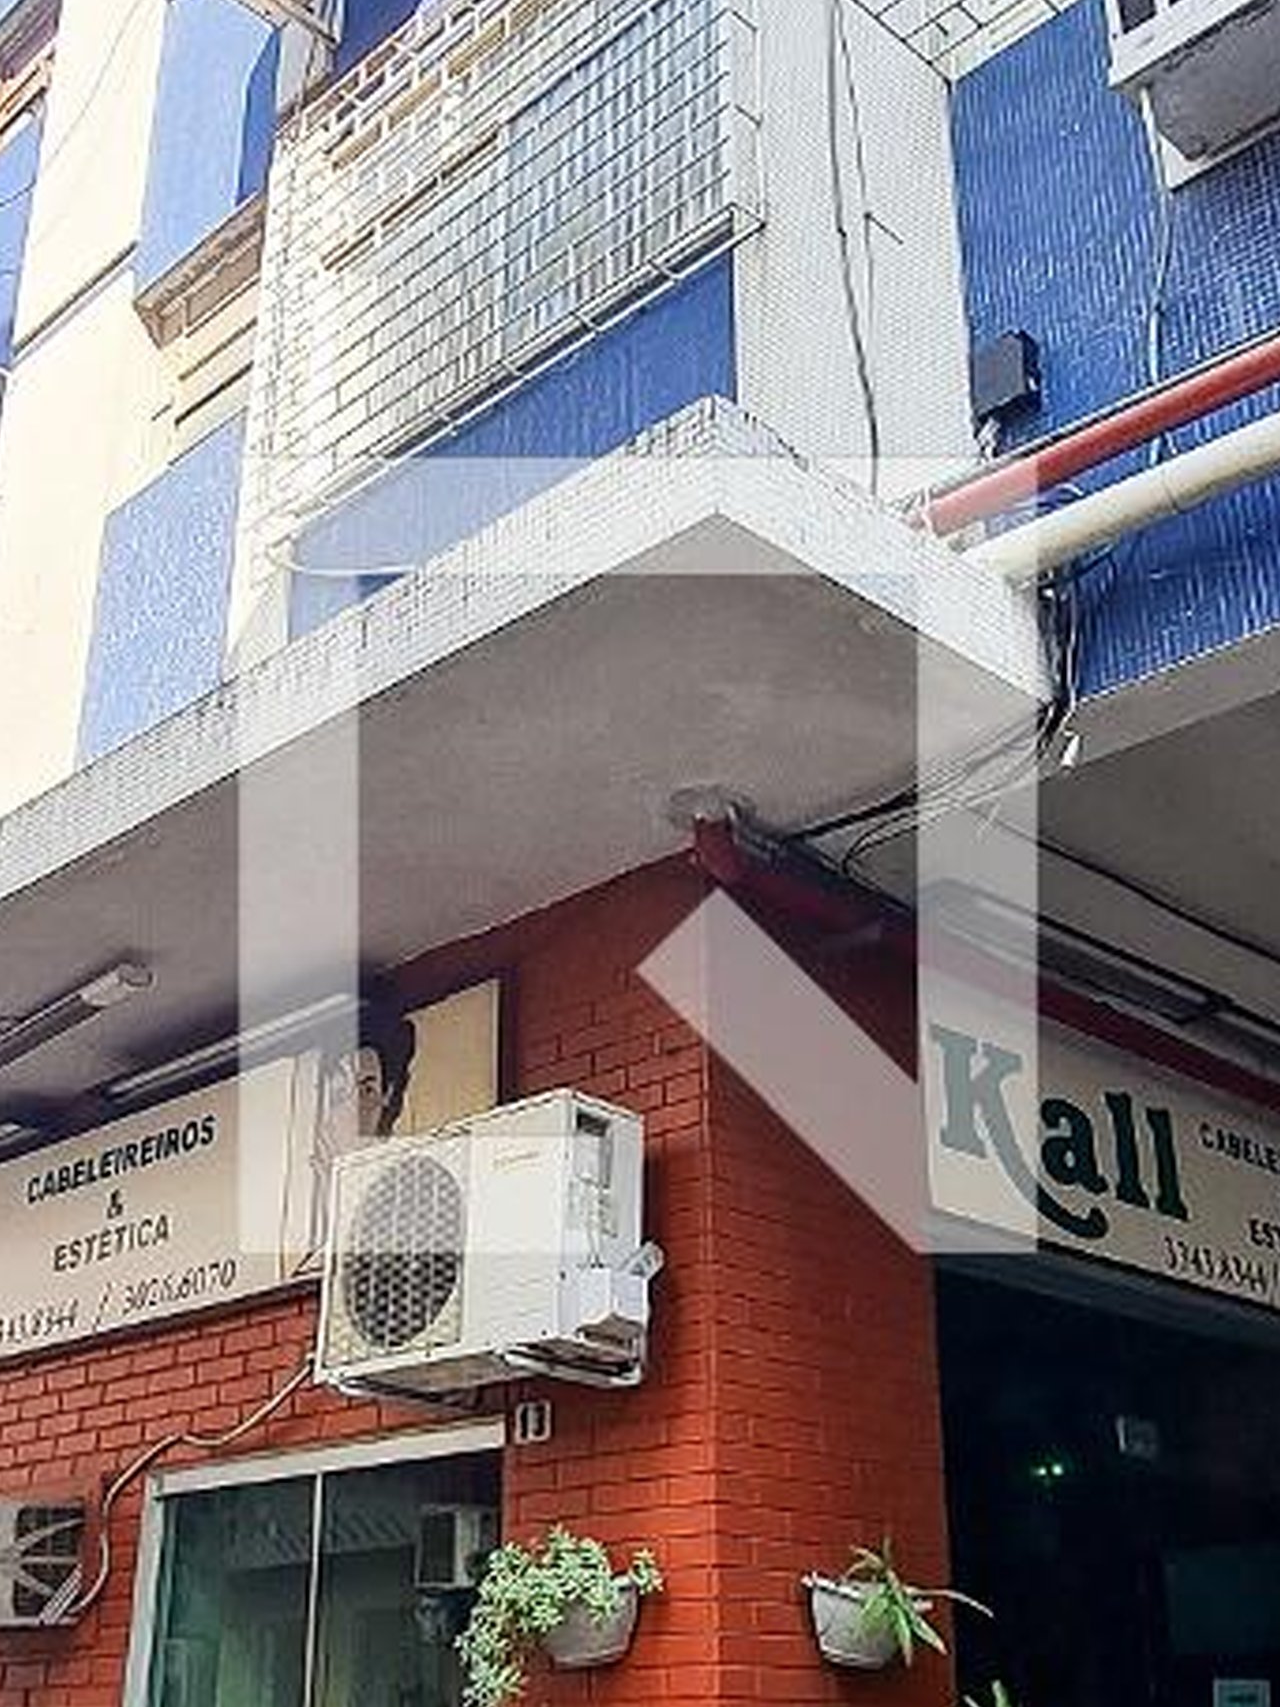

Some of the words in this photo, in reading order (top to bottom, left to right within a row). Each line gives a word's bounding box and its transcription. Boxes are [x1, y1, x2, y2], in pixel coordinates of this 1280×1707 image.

[27, 1114, 216, 1205] CABELEIREIROS
[929, 1023, 1188, 1239] Kall
[53, 1212, 170, 1271] ESTÉTICA
[107, 1189, 124, 1219] &
